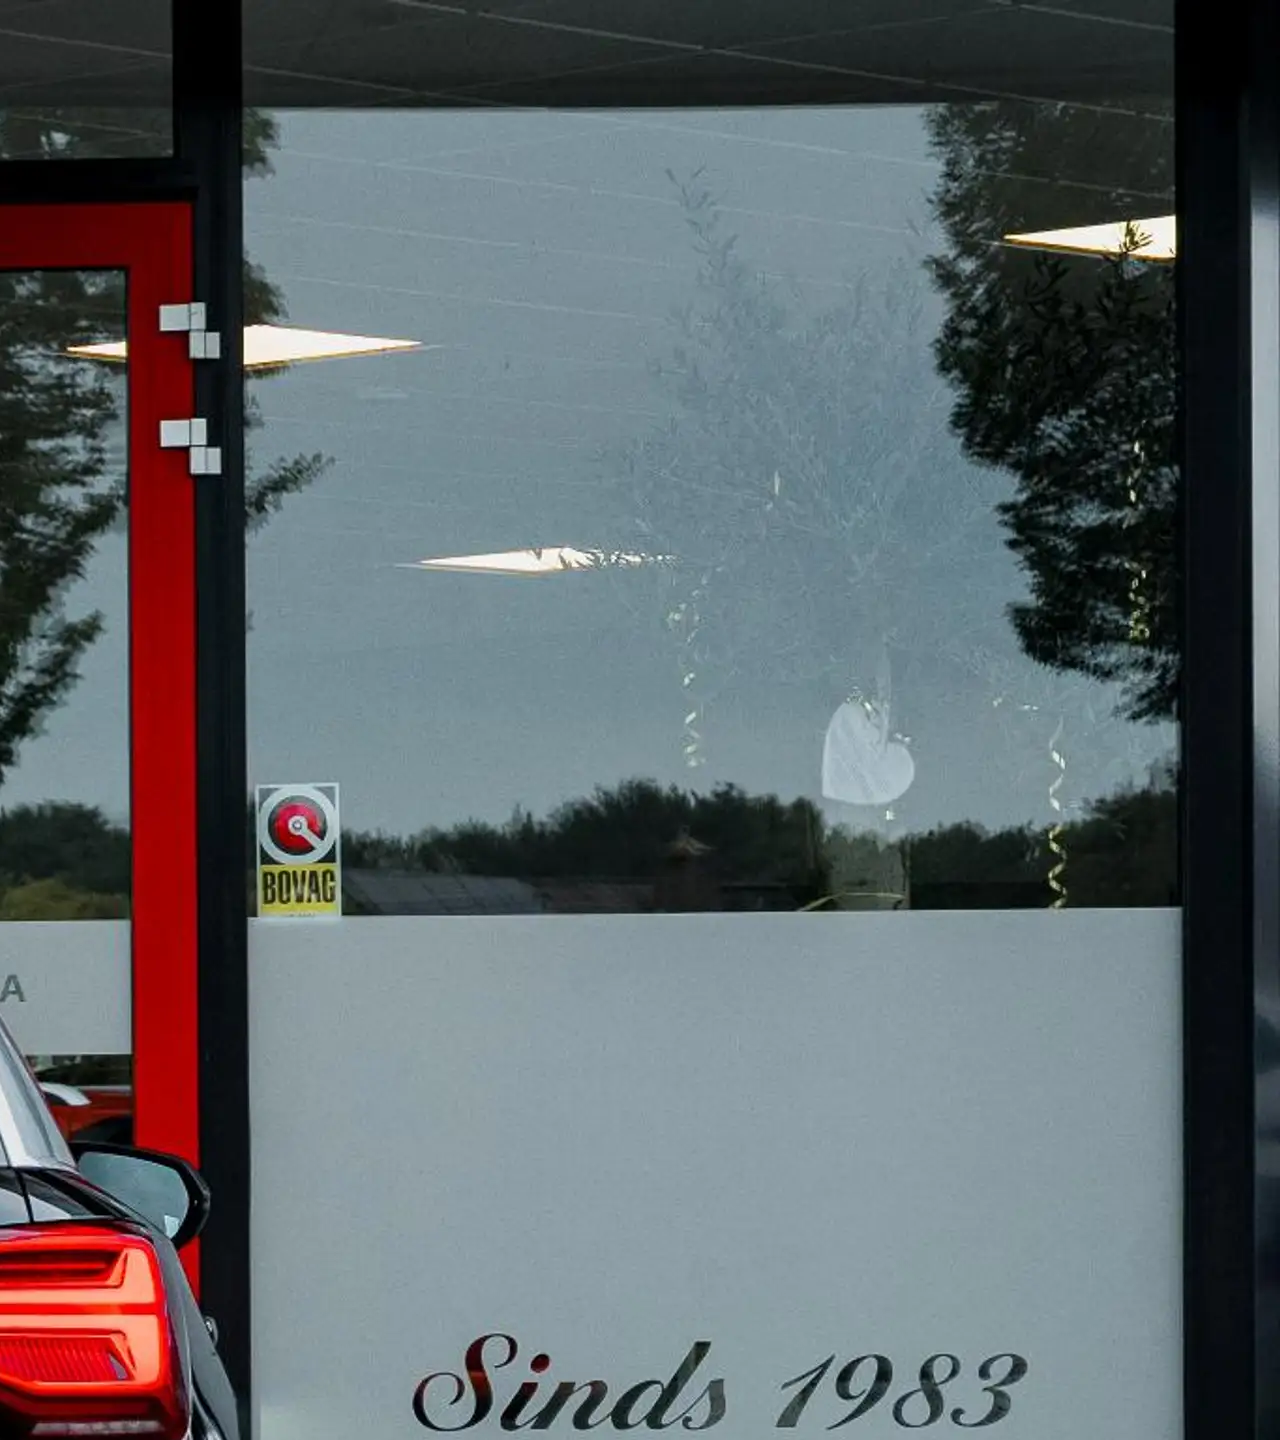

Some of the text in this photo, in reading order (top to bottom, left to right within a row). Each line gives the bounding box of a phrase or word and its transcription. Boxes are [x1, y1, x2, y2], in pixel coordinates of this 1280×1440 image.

[262, 869, 337, 905] BOVAG
[411, 1332, 1029, 1432] Sinds 1983
